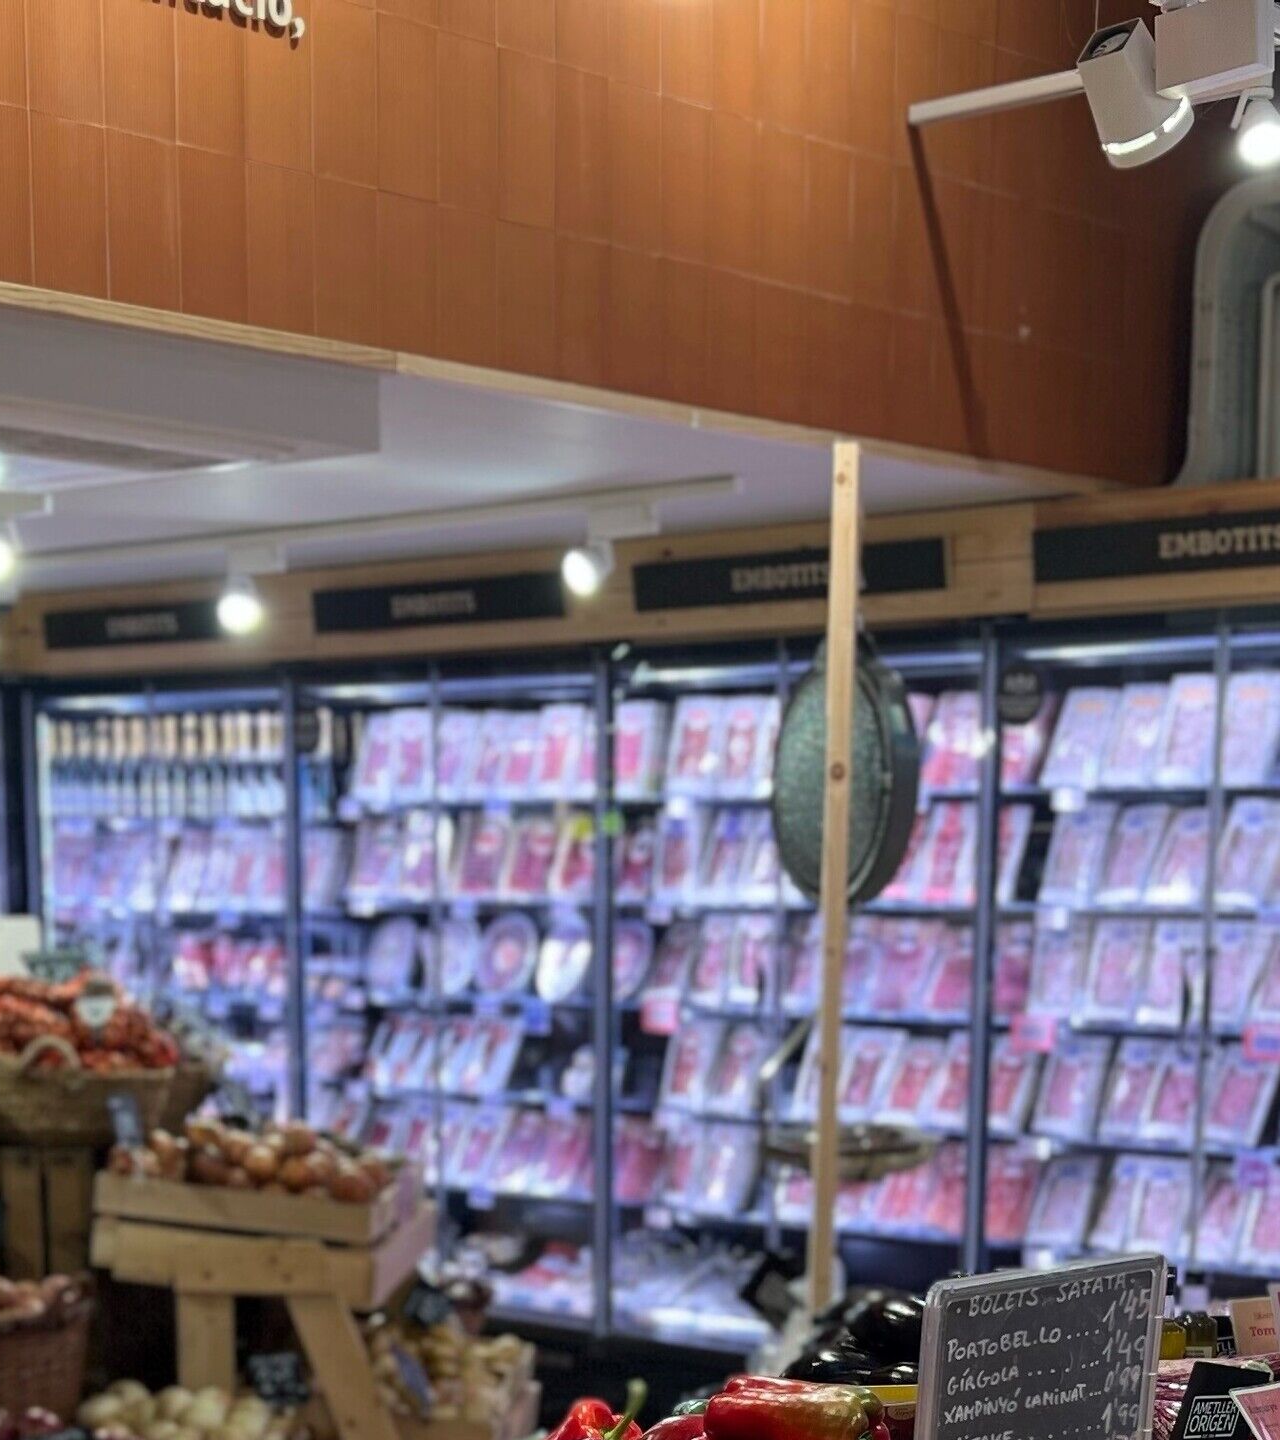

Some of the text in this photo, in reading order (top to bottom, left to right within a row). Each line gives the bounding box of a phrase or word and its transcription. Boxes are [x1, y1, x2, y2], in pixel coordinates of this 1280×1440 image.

[969, 1287, 1041, 1318] BOLETS
[947, 1364, 1020, 1397] GÍRGOLA
[1191, 1401, 1239, 1416] AMETLLER
[1189, 1413, 1236, 1433] ORIGEN
